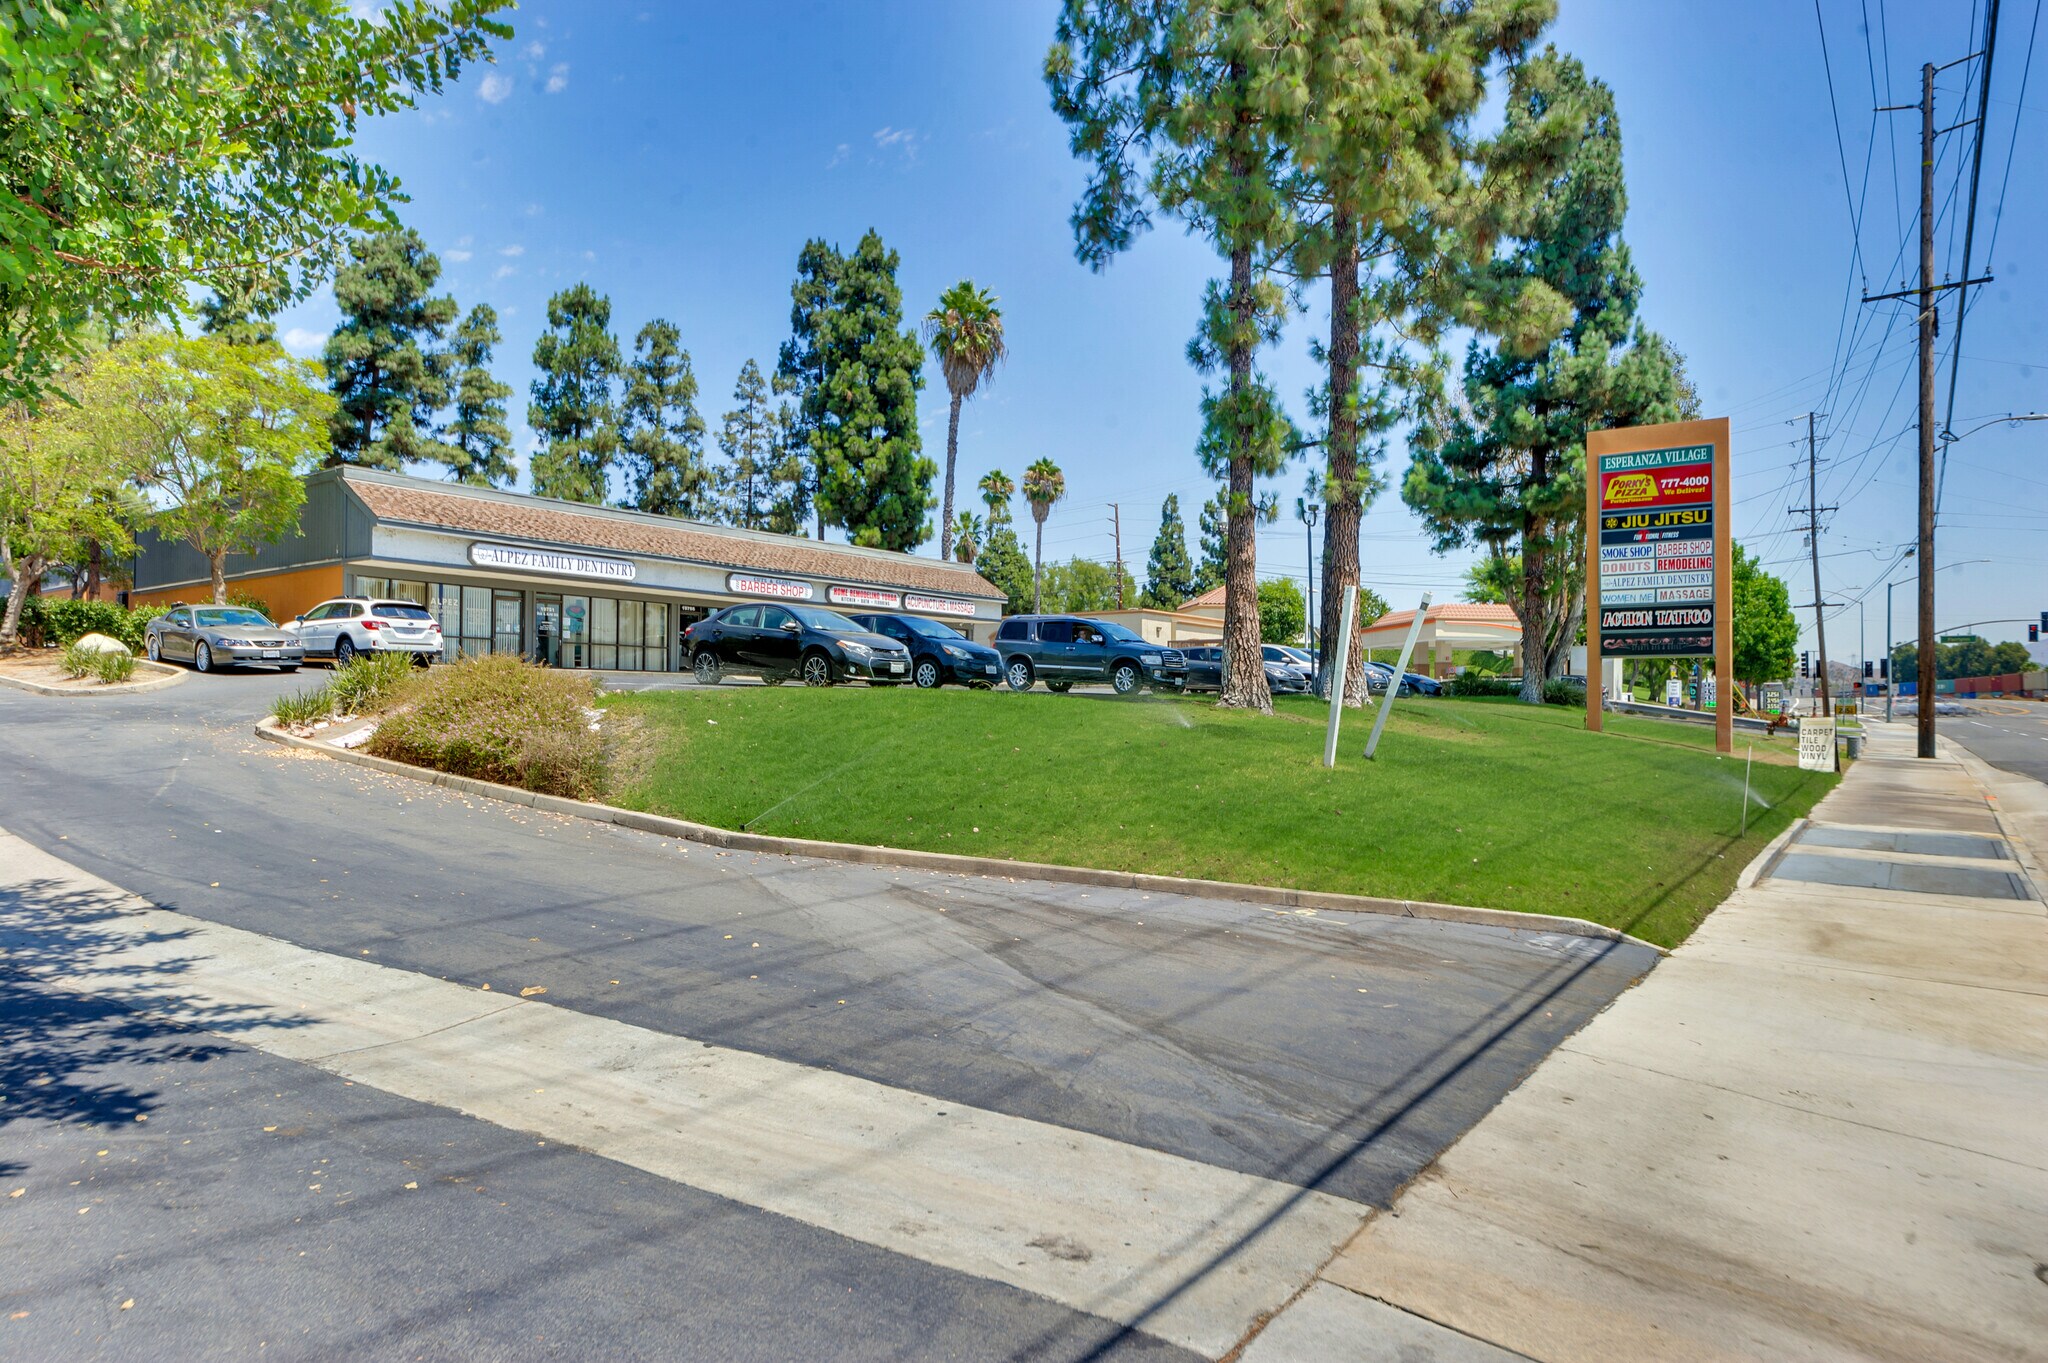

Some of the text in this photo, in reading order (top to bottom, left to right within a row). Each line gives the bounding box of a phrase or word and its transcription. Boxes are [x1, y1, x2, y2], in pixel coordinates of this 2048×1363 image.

[1604, 447, 1708, 470] ESPERANZA VILLAGE
[1661, 476, 1709, 488] 777-4000
[1614, 488, 1647, 497] PIZZA
[1621, 510, 1708, 529] JIU JITSU
[1601, 546, 1653, 559] SMOKE SHOP
[1657, 541, 1712, 556] BARBER SHOP
[491, 549, 636, 578] ALPEZ FAMILY DENTISTRY
[1602, 561, 1652, 573] DONUTS
[1657, 556, 1713, 571] REMODELING
[1611, 572, 1712, 588] ALPEZ FAMILY DENTISTRY
[740, 580, 805, 598] BARBER SHOP
[833, 587, 849, 597] HOME
[850, 589, 881, 600] REMODELING
[1660, 589, 1710, 600] MASSAGE
[430, 598, 459, 606] ALPEZ
[907, 596, 946, 610] ACUPUNCTURE
[949, 601, 975, 614] MASSAGE
[1601, 594, 1637, 603] WOMEN
[1602, 608, 1713, 627] ACTION TATTOO
[1801, 744, 1827, 752] WOOD
[1801, 752, 1827, 760] VINYL
